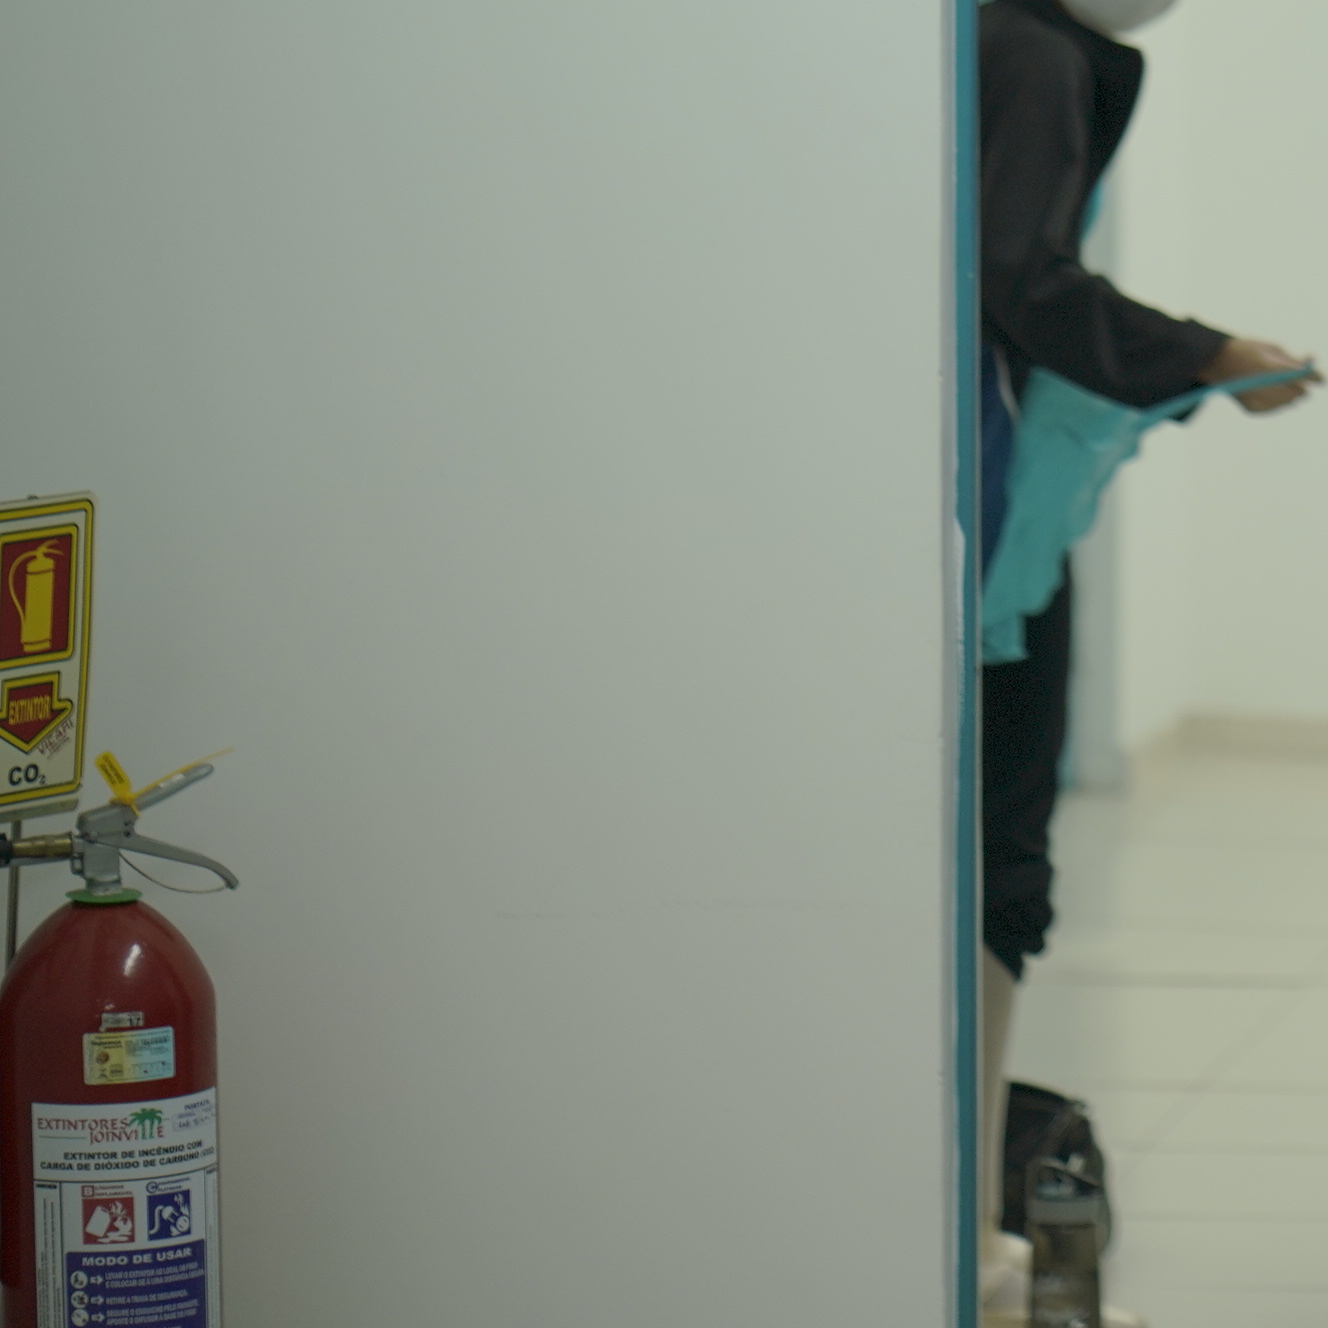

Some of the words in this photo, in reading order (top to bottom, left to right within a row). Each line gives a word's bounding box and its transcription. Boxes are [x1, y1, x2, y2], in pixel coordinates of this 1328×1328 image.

[8, 694, 51, 725] EXTINTOR
[37, 1118, 129, 1131] EXTINTORES
[63, 1151, 117, 1160] EXTINTOR
[121, 1150, 135, 1158] DE
[138, 1144, 184, 1157] INCÊNDIO
[186, 1140, 203, 1150] COM
[40, 1162, 73, 1170] CARGA
[76, 1162, 91, 1171] DE
[94, 1160, 139, 1170] DIÓXIDO
[142, 1158, 156, 1167] DE
[159, 1152, 199, 1166] CARBONO
[81, 1256, 128, 1266] MODO
[133, 1253, 153, 1264] DE
[156, 1247, 192, 1262] USAR
